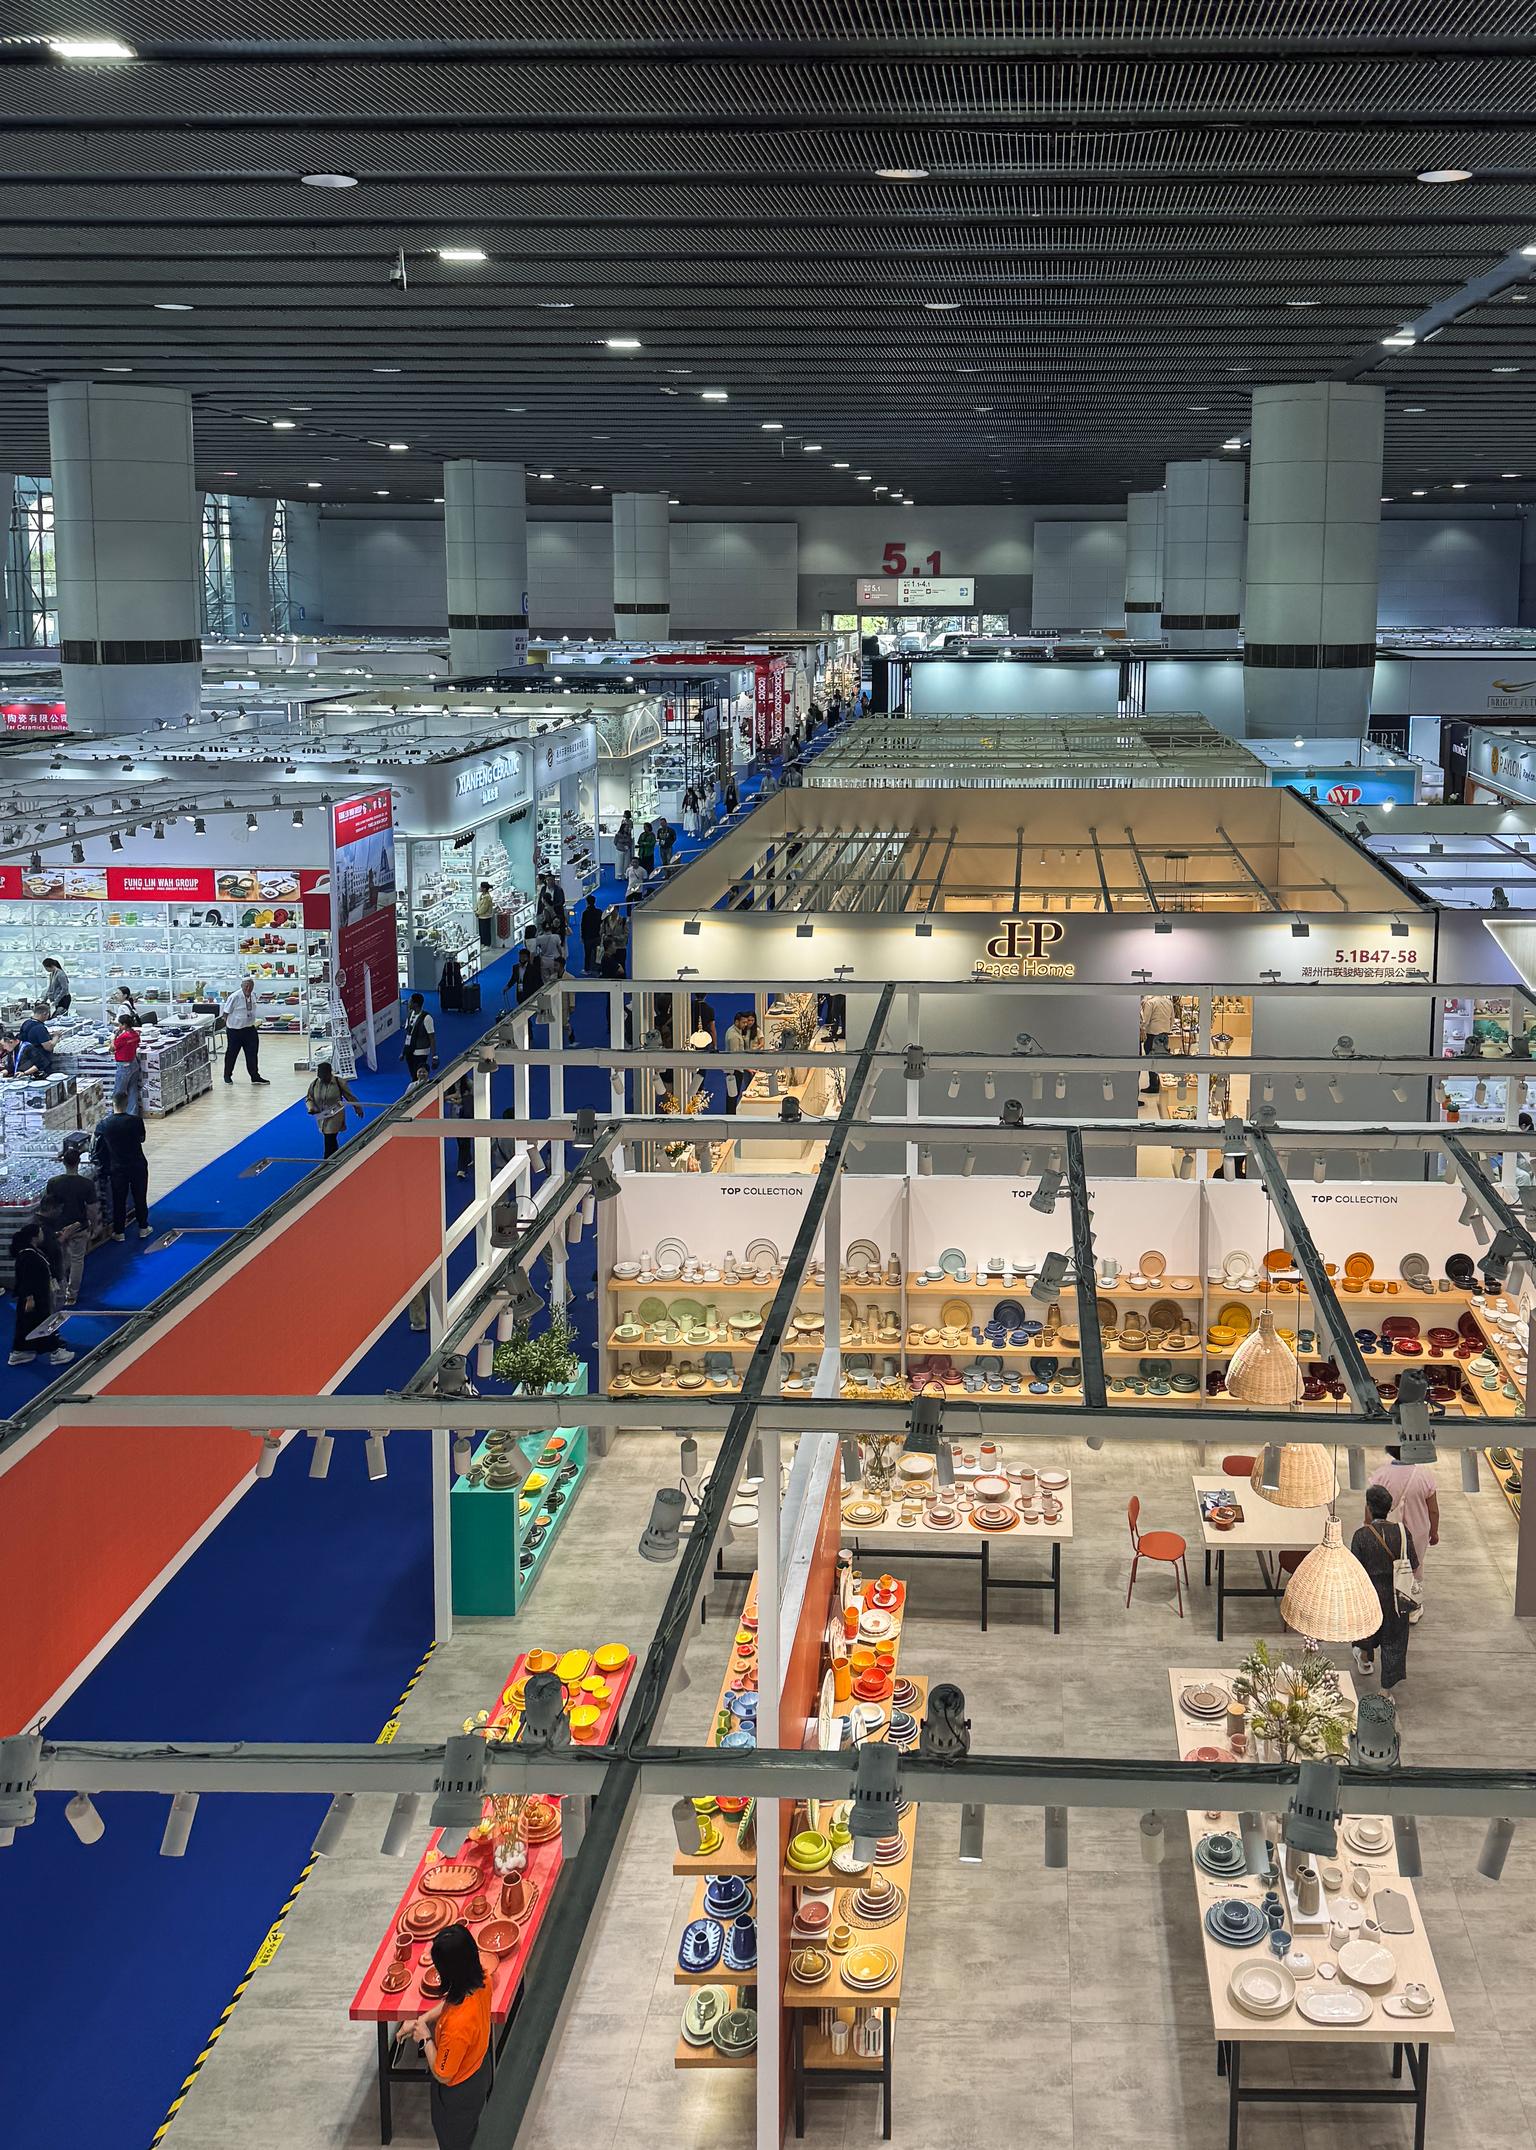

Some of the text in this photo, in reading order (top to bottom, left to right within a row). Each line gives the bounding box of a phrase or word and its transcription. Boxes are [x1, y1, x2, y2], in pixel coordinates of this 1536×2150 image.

[882, 543, 941, 576] 5.1
[458, 757, 519, 795] XIANFENG CERAMIC
[124, 878, 199, 887] FUNG LIN WAH GROUP
[1335, 950, 1417, 963] 5.1B47-58
[975, 960, 1074, 976] Peace Home
[721, 1187, 803, 1196] TOP COLLECTION
[1012, 1190, 1032, 1198] TOP
[1312, 1195, 1398, 1204] TOP COLLECTION
